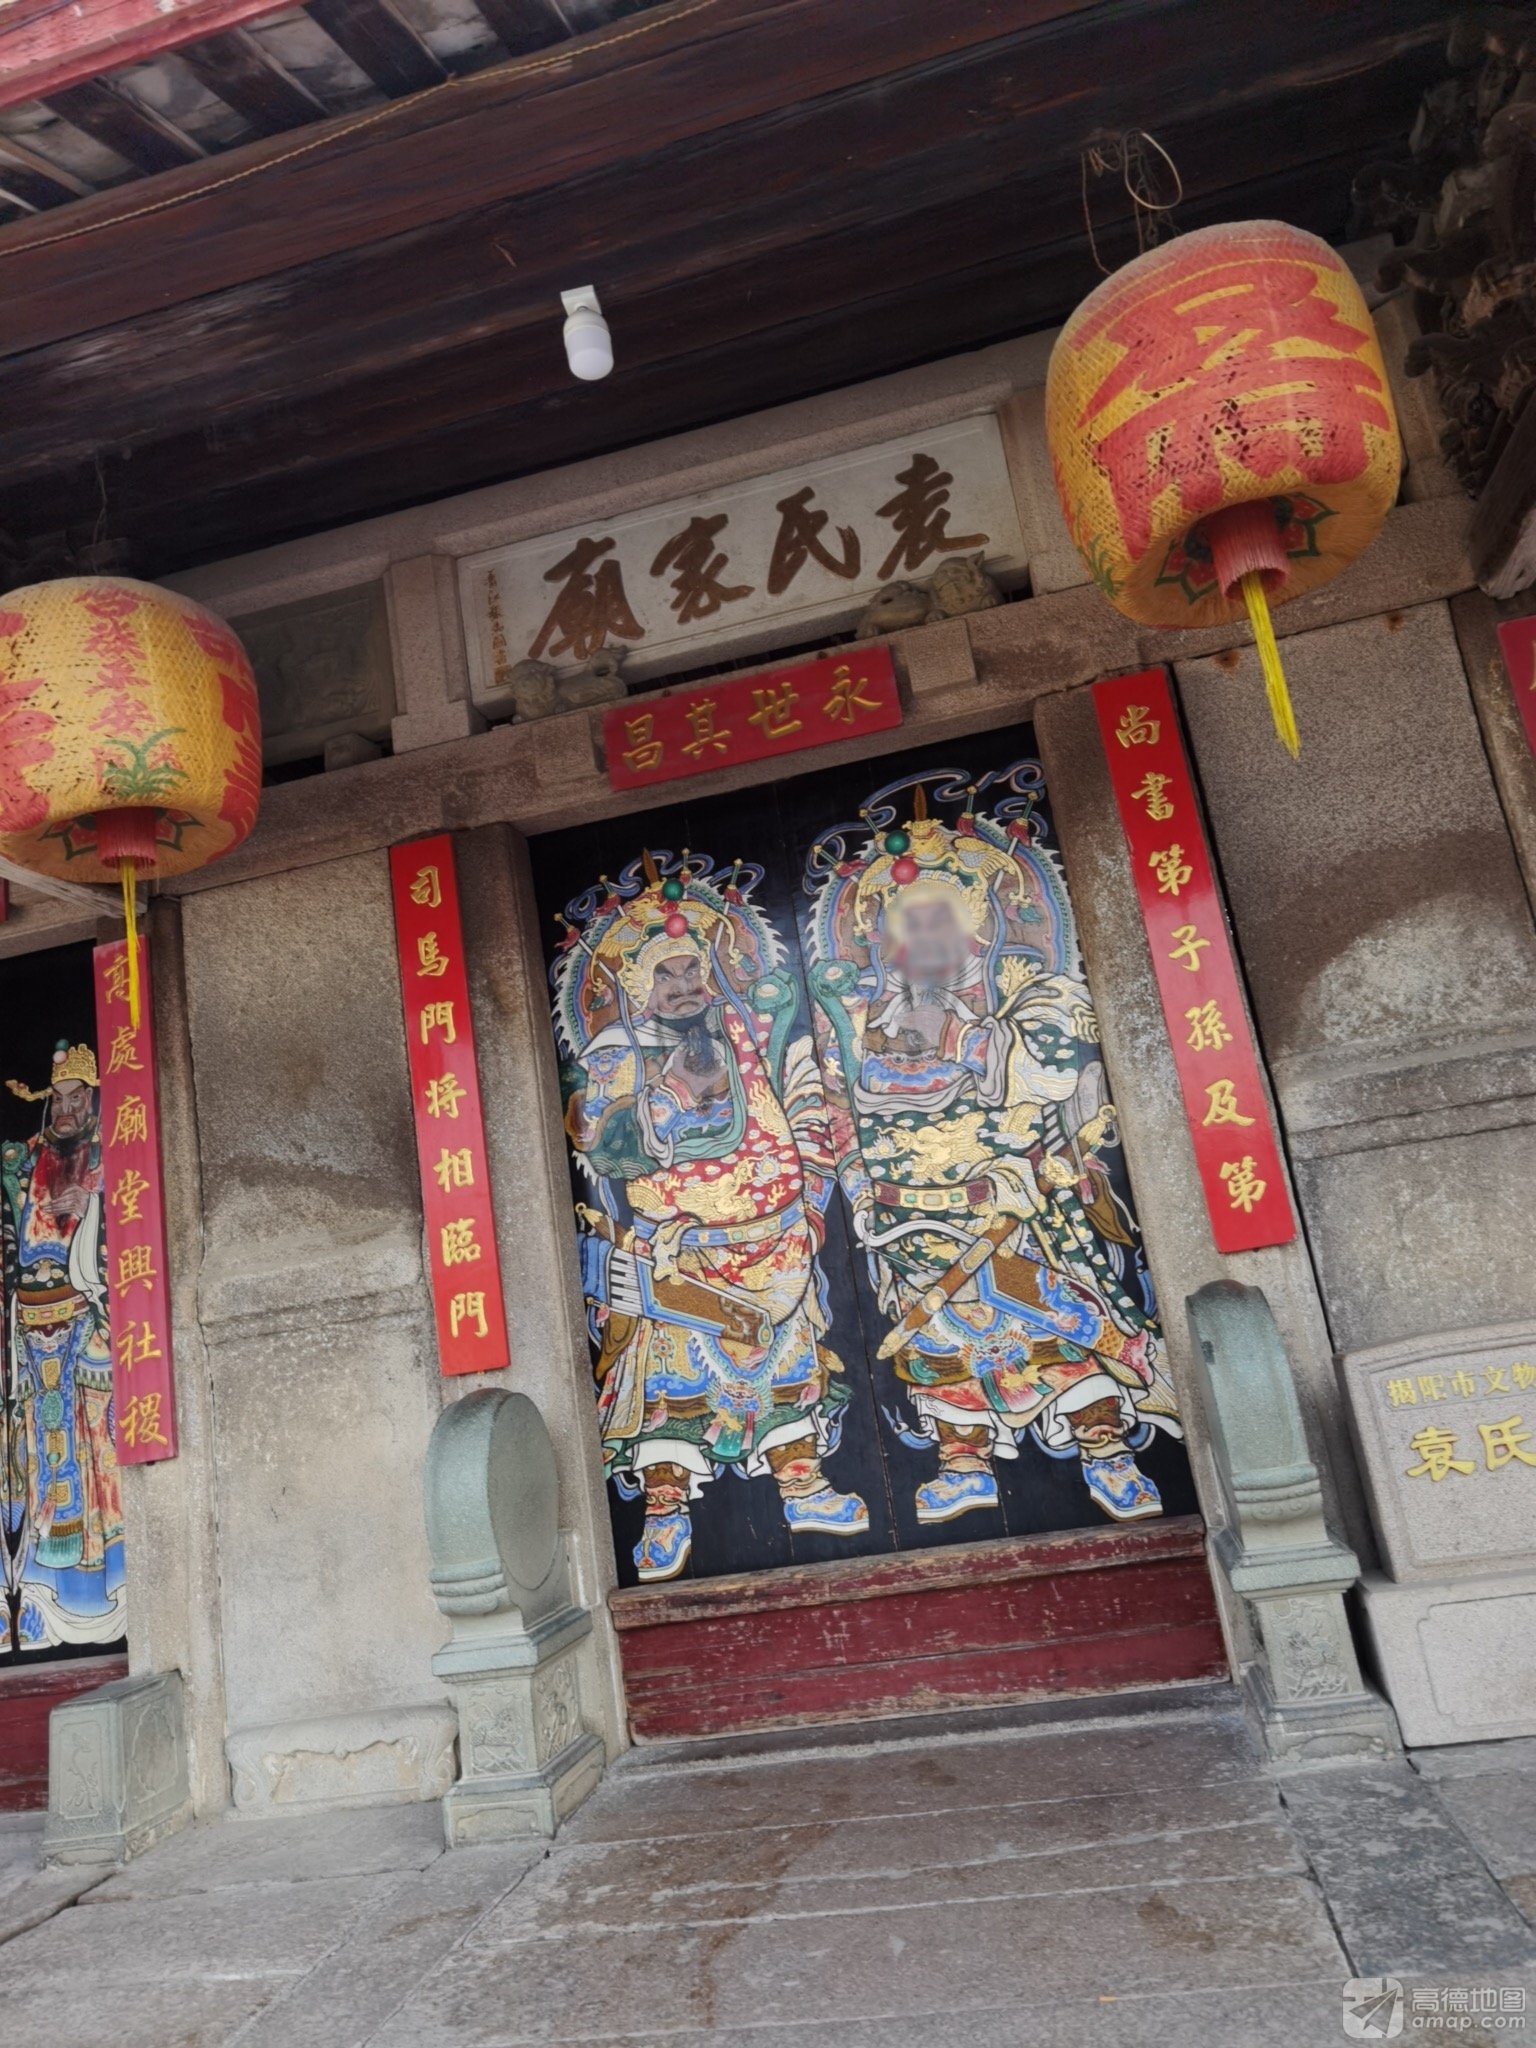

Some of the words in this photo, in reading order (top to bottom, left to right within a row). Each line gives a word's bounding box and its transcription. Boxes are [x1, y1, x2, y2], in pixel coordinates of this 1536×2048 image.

[527, 452, 990, 660] 袁氏家廟
[622, 664, 883, 773] 永世其昌
[1114, 704, 1268, 1214] 尚書第子孫及第
[1406, 1415, 1536, 1482] 袁氏
